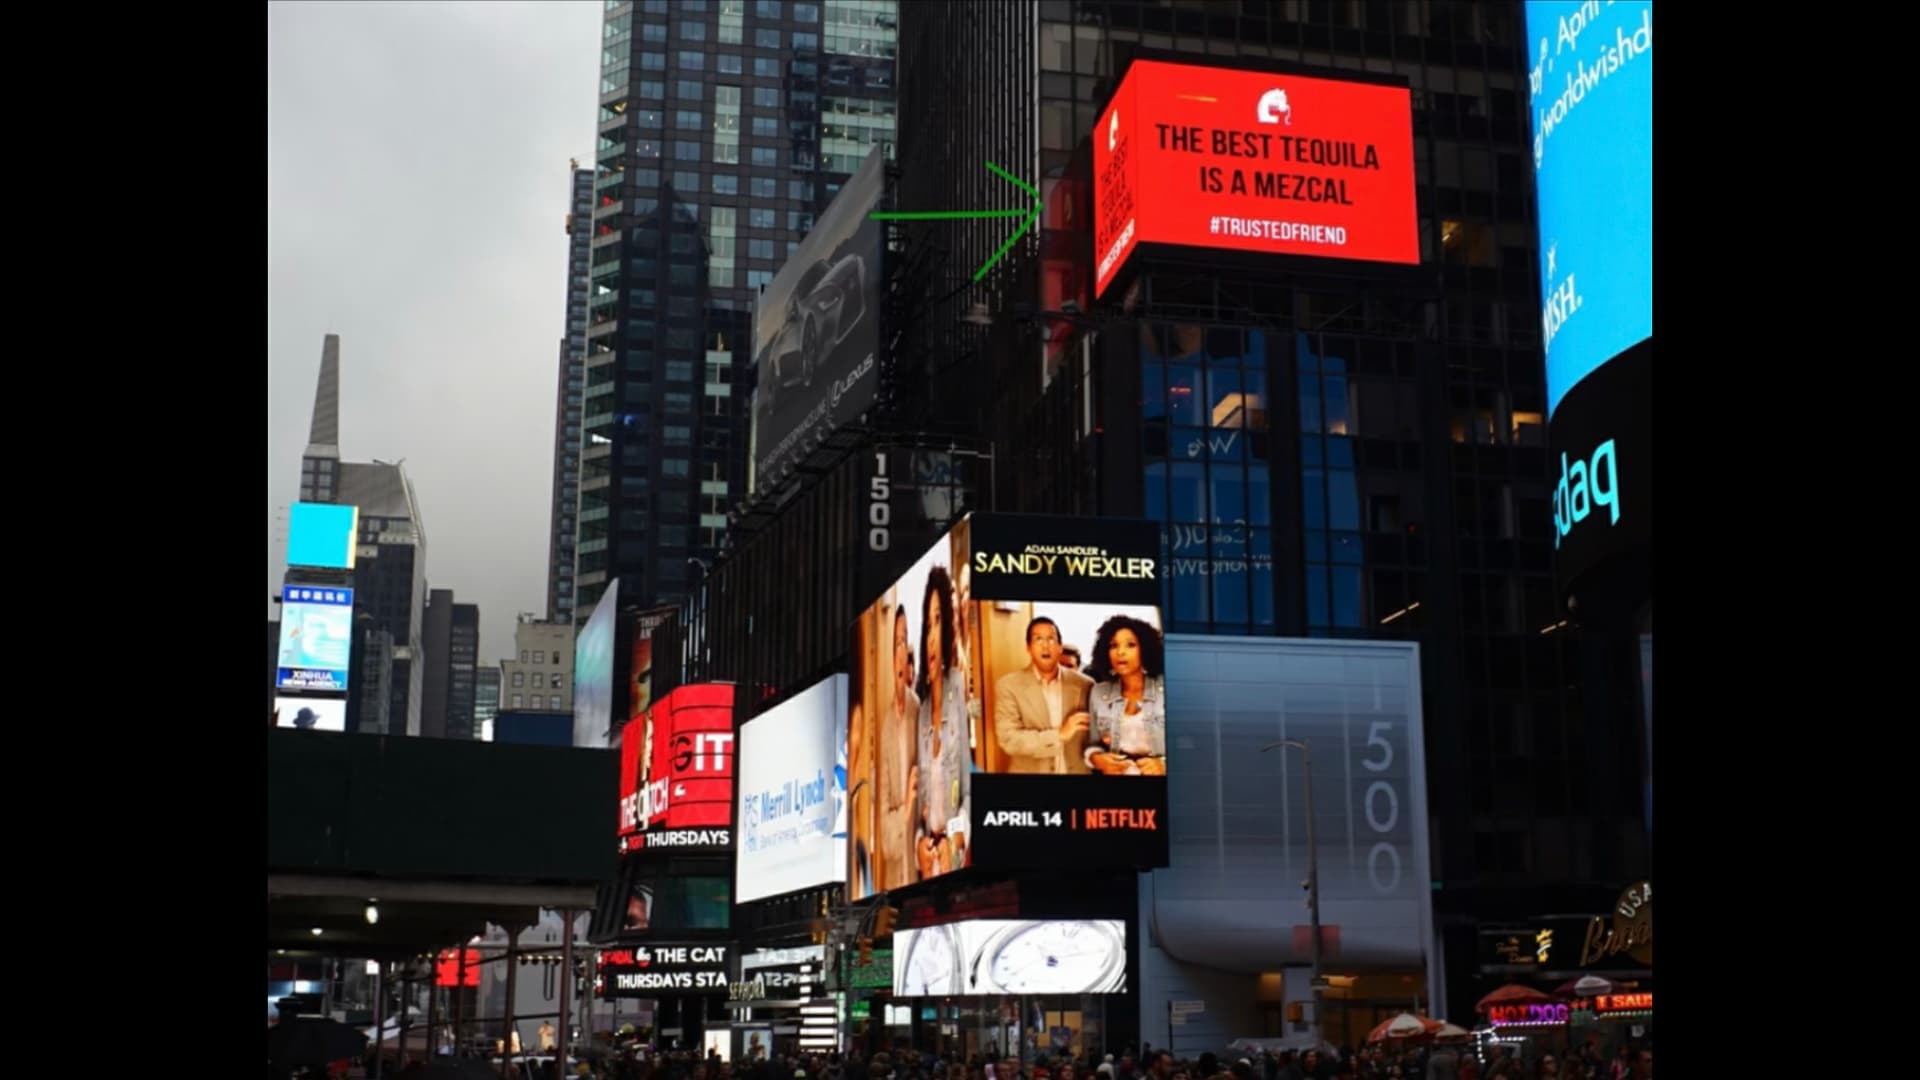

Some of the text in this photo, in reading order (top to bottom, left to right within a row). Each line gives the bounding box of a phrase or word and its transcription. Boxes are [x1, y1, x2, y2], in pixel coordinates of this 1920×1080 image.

[1156, 123, 1380, 170] THE BEST TEQUILA
[1200, 166, 1354, 205] IS A MEZCAL
[1210, 216, 1346, 245] #TRUSTEDFRIEND
[840, 352, 874, 393] LEXUS
[869, 452, 891, 552] 1500
[1025, 544, 1056, 554] ADAM
[1057, 545, 1099, 556] SANDLER
[975, 551, 1057, 575] SANDY
[1065, 556, 1155, 579] WEXLER
[292, 671, 334, 681] XINHUA
[621, 792, 638, 830] THE
[983, 808, 1156, 830] APRIL 14 NETFLIX
[646, 830, 729, 847] THURSDAYS
[1619, 883, 1652, 918] USA
[655, 947, 726, 963] THE CAT
[616, 971, 727, 989] THURSDAYS STA
